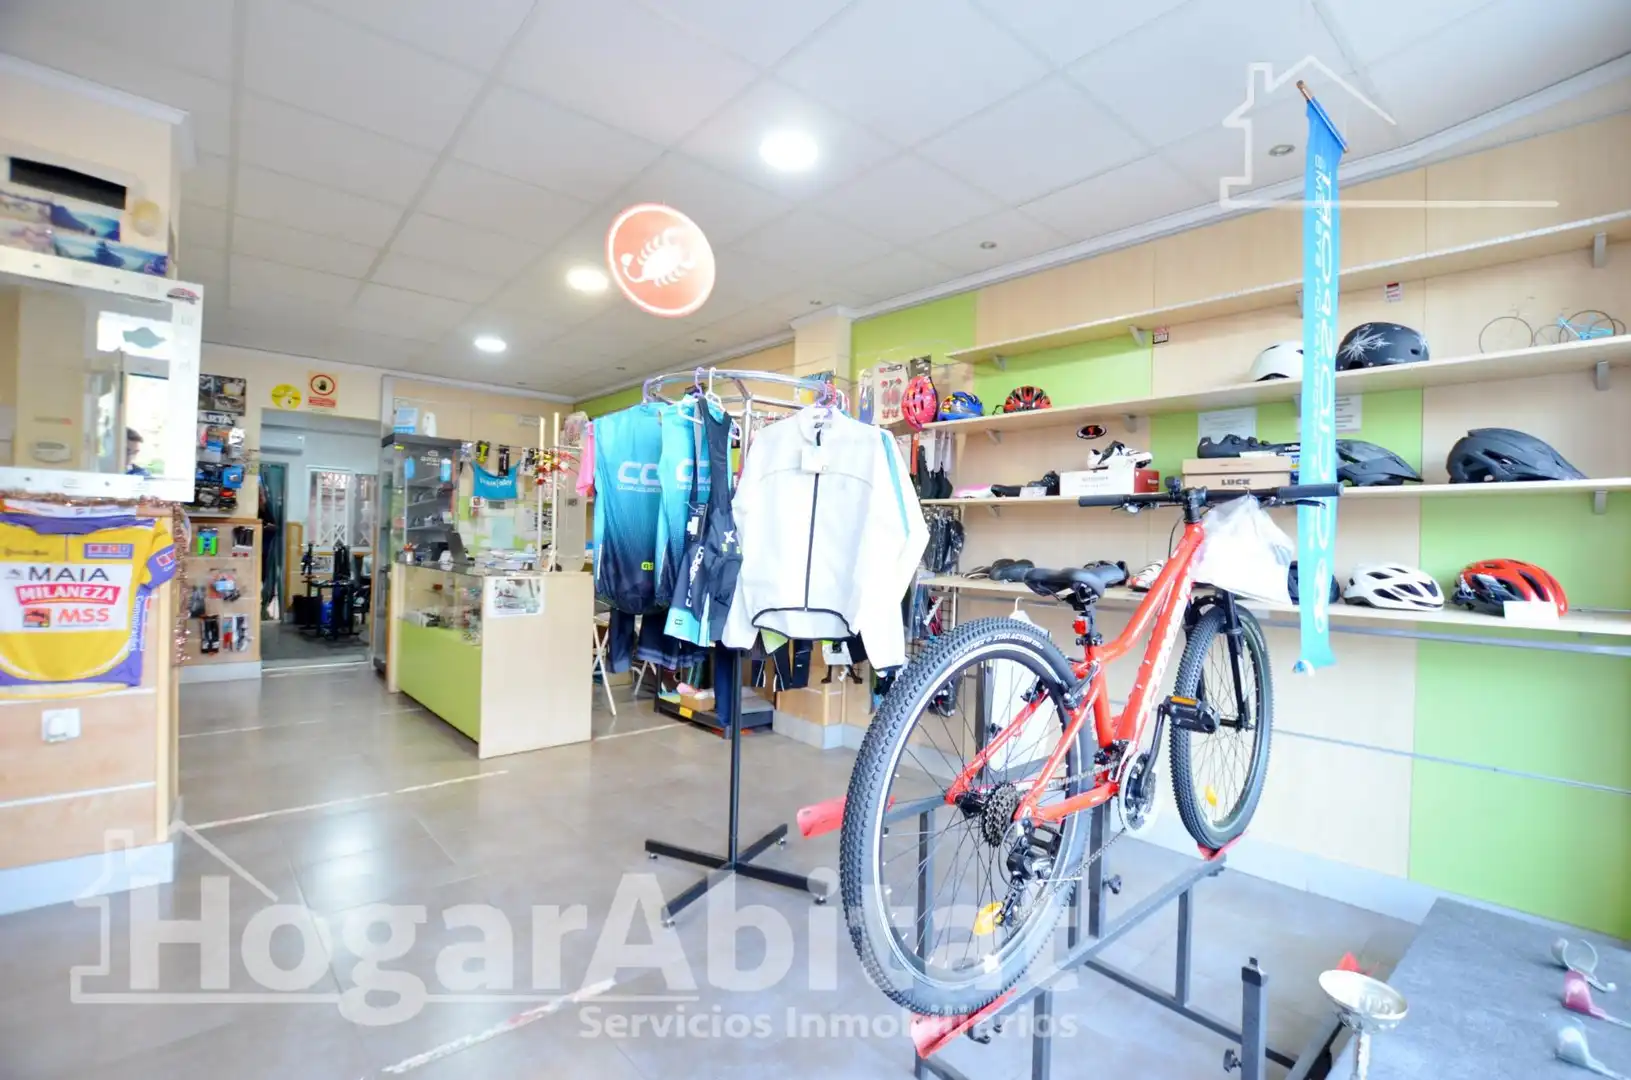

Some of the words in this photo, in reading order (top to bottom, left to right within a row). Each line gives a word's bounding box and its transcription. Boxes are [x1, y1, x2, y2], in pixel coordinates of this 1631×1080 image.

[1221, 478, 1251, 487] LUCK
[29, 566, 110, 582] MAIA
[19, 585, 115, 602] MILANEZA
[57, 608, 110, 624] MSS
